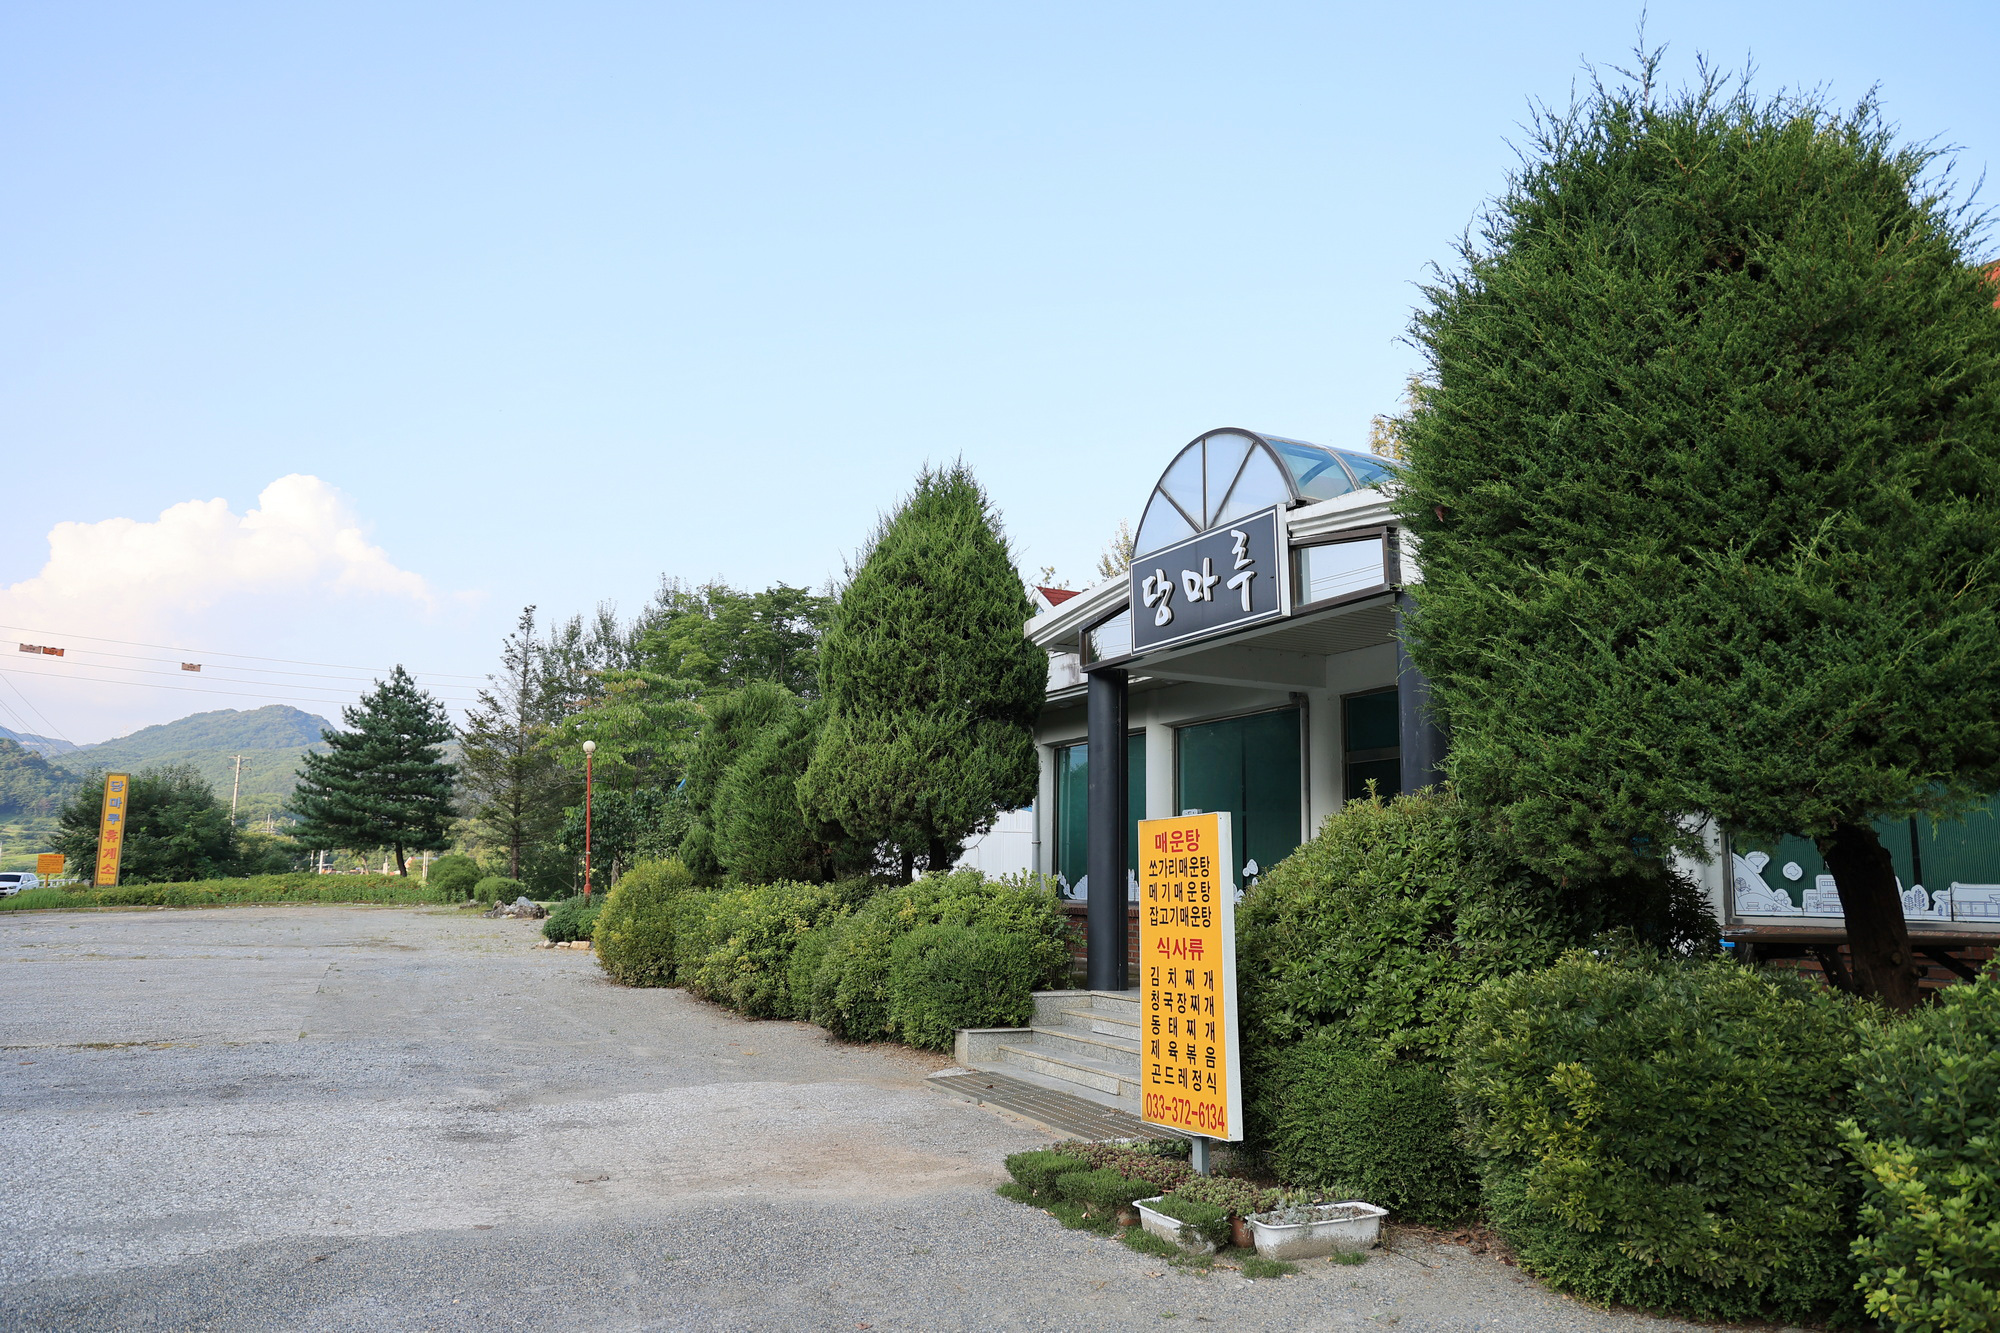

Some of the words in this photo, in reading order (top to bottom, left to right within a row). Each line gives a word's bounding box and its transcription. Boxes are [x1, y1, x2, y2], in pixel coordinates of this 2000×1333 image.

[1141, 529, 1257, 627] 당마루
[1155, 828, 1200, 853] 매운탕
[1149, 856, 1210, 878] 쏘가리매운탕
[1150, 906, 1211, 928] 잡고기매운탕
[1157, 937, 1204, 961] 식사류
[1151, 990, 1215, 1017] 청국장찌개
[1151, 1064, 1217, 1095] 곤드레정식
[1146, 1093, 1225, 1132] 033-372-6134
